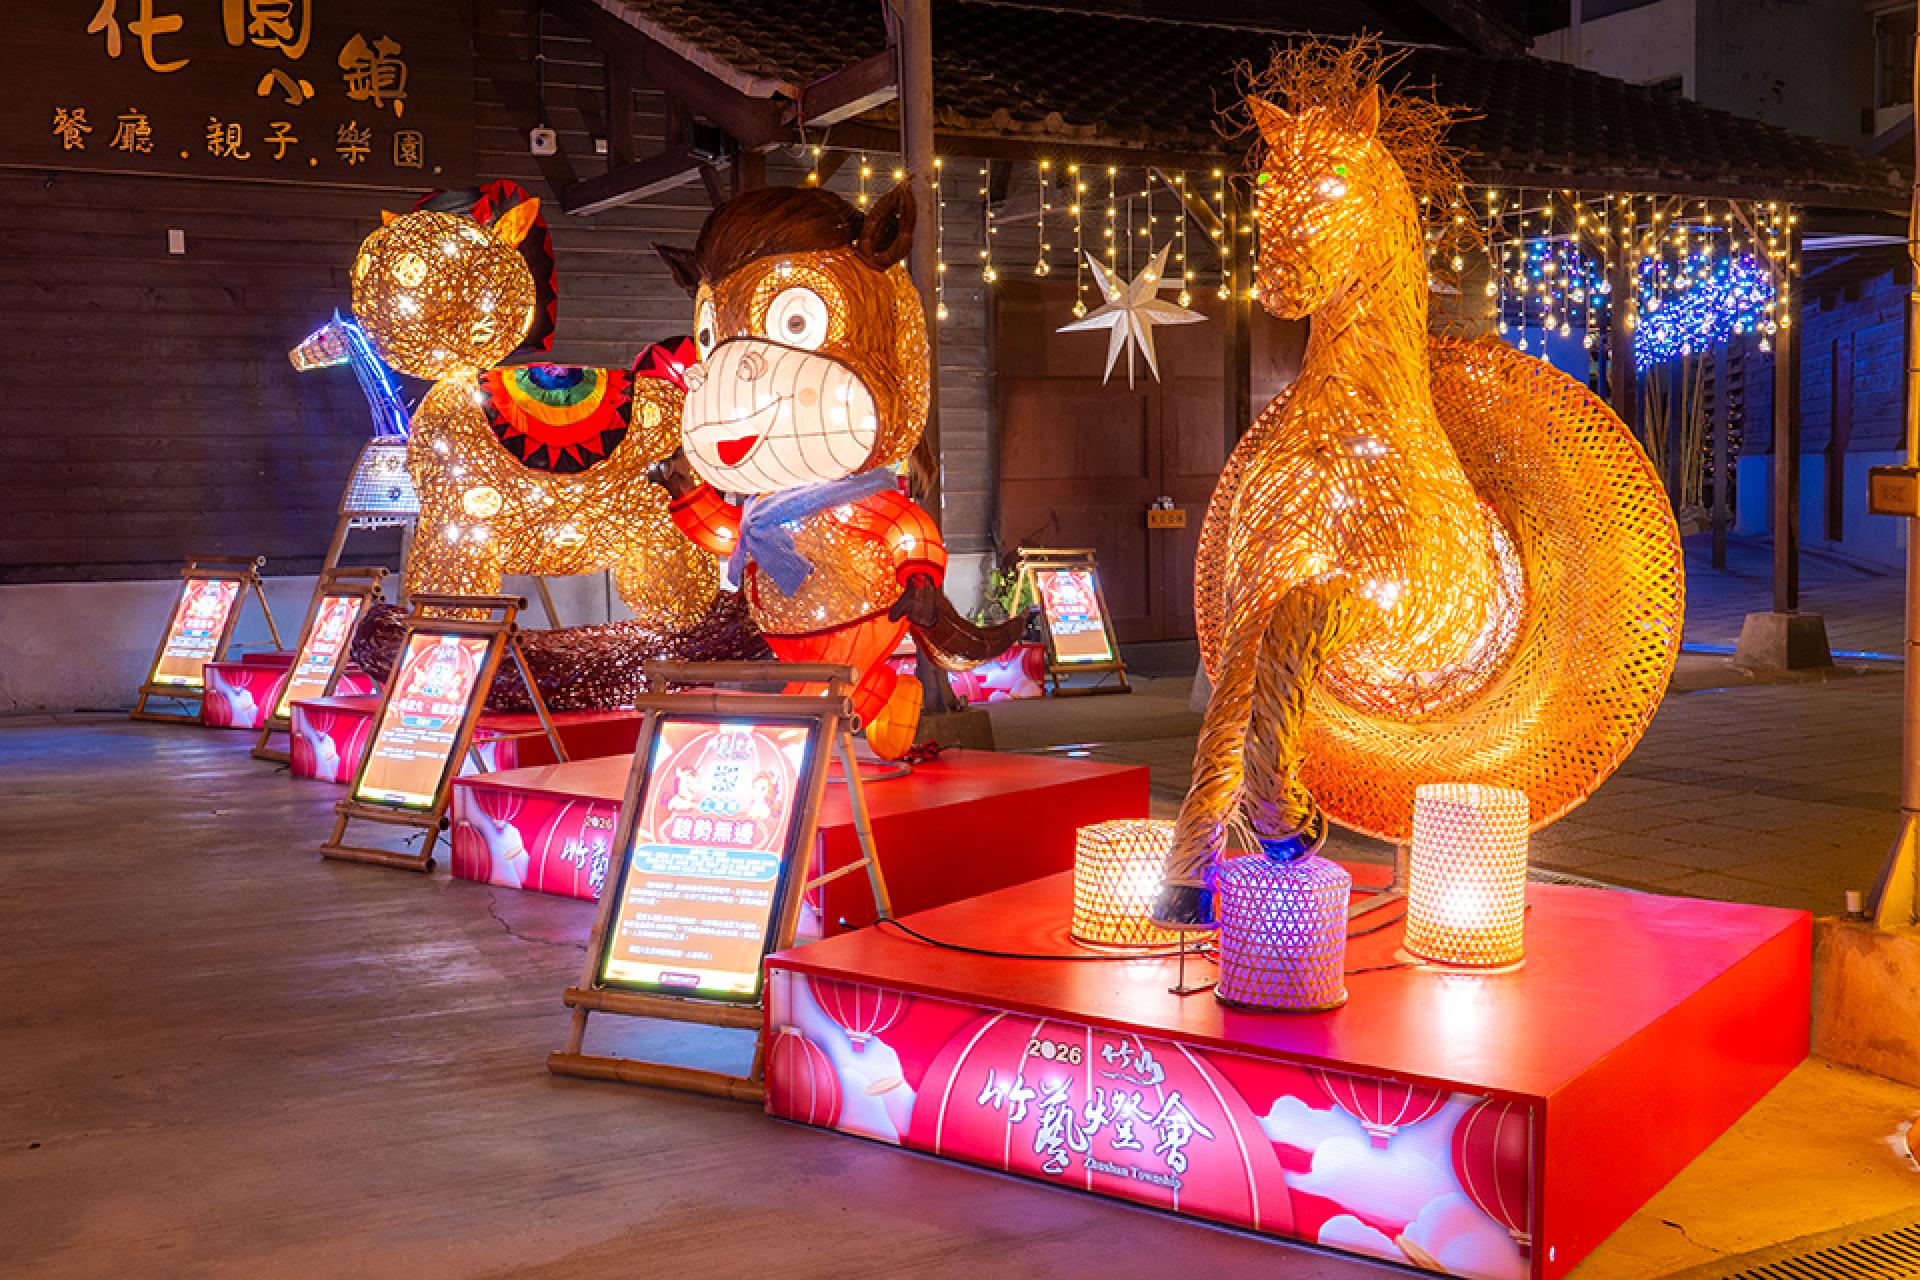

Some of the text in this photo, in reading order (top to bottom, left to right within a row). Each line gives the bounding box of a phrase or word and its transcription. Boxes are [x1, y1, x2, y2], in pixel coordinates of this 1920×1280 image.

[1028, 1038, 1083, 1066] 2026
[976, 1067, 1216, 1174] 竹藝燈會
